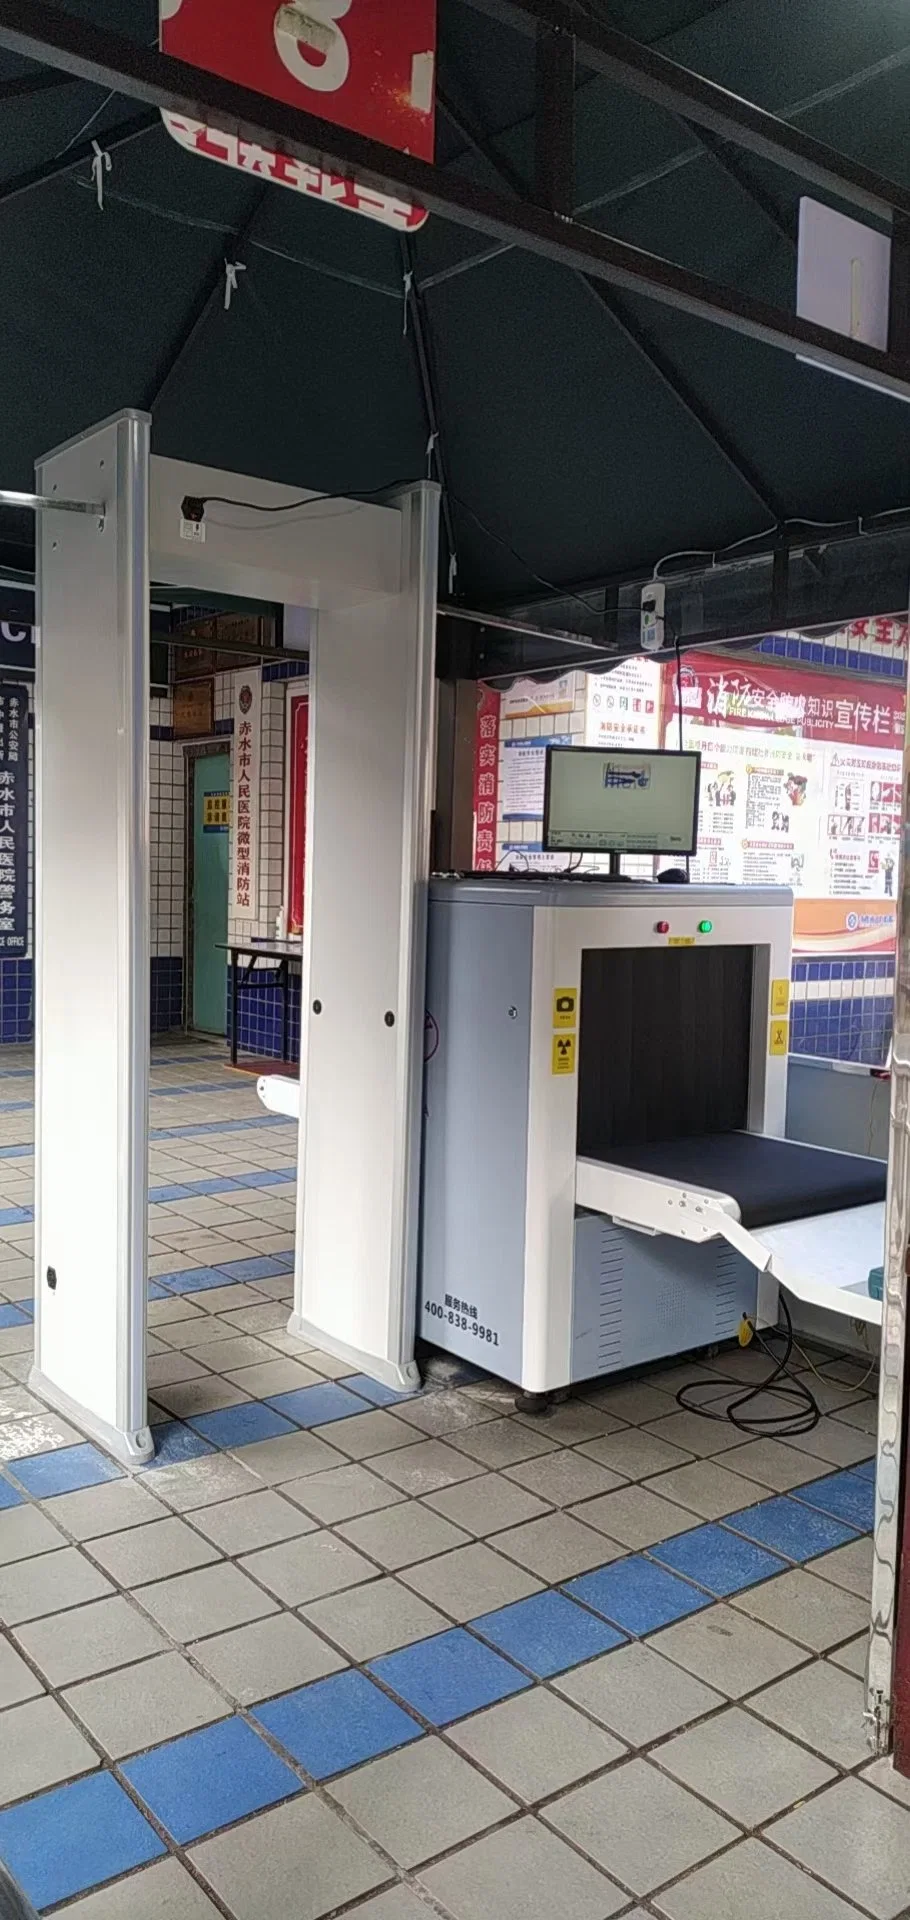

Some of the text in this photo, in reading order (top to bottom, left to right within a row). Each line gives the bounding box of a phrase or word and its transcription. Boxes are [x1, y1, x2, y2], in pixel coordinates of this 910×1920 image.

[0, 770, 16, 931] 赤水市人民医院警务室
[236, 721, 253, 908] 赤水市人民医院微型消防站
[476, 715, 497, 871] 落实消防责任
[424, 1300, 499, 1346] 400-838-9981
[444, 1293, 478, 1320] 服务热线
